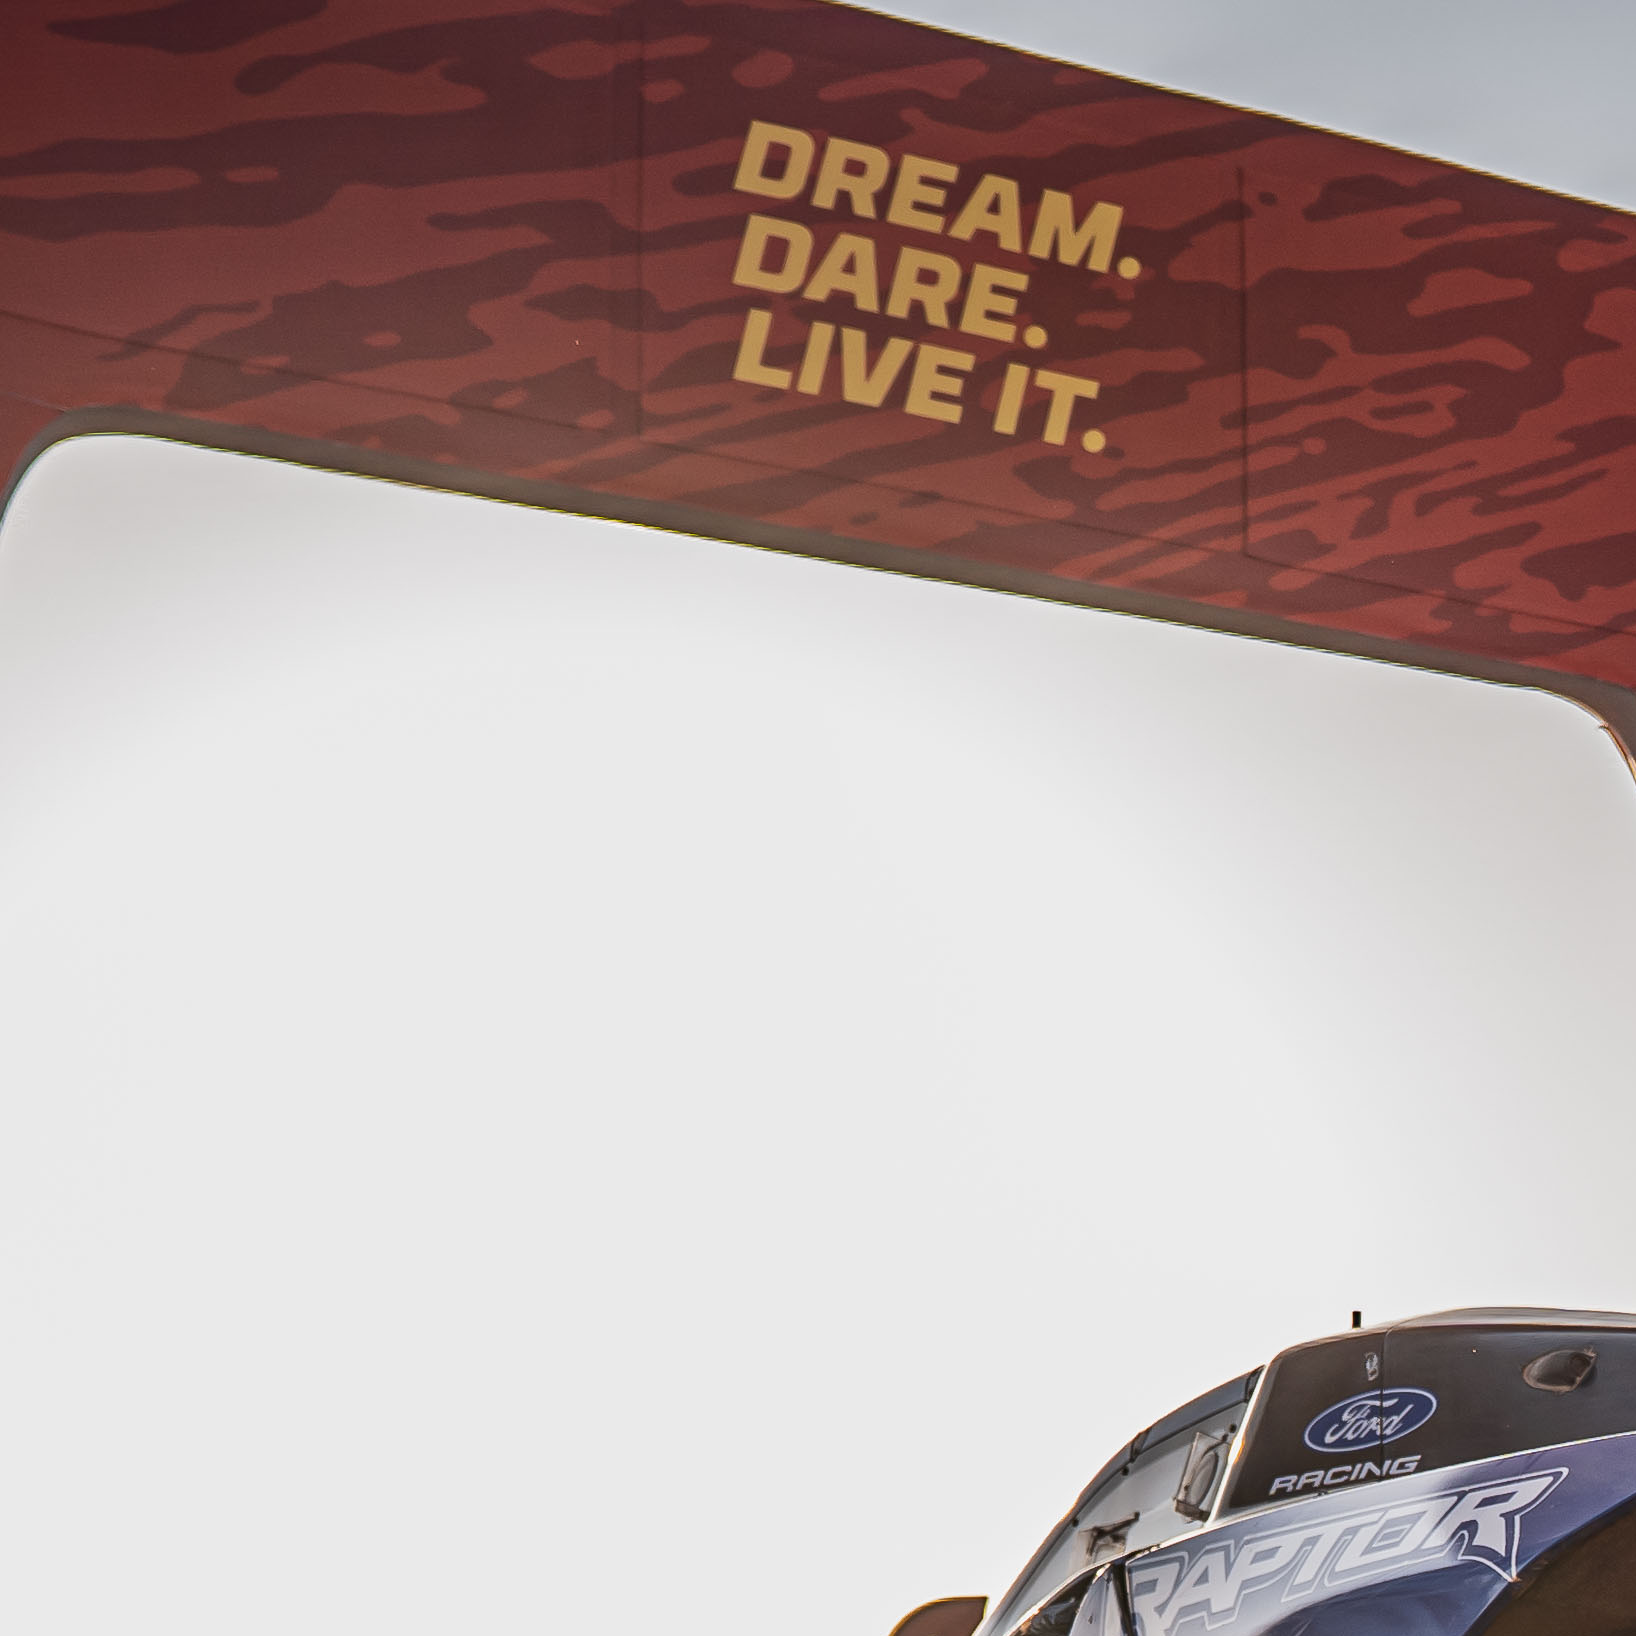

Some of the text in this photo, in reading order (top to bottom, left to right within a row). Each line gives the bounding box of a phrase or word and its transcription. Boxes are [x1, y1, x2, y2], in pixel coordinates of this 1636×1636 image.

[733, 120, 1141, 279] DREAM.
[732, 213, 1048, 349] DARE.
[733, 307, 1106, 453] LIVE IT.
[1269, 1455, 1422, 1496] RACING
[1326, 1398, 1414, 1445] Ford
